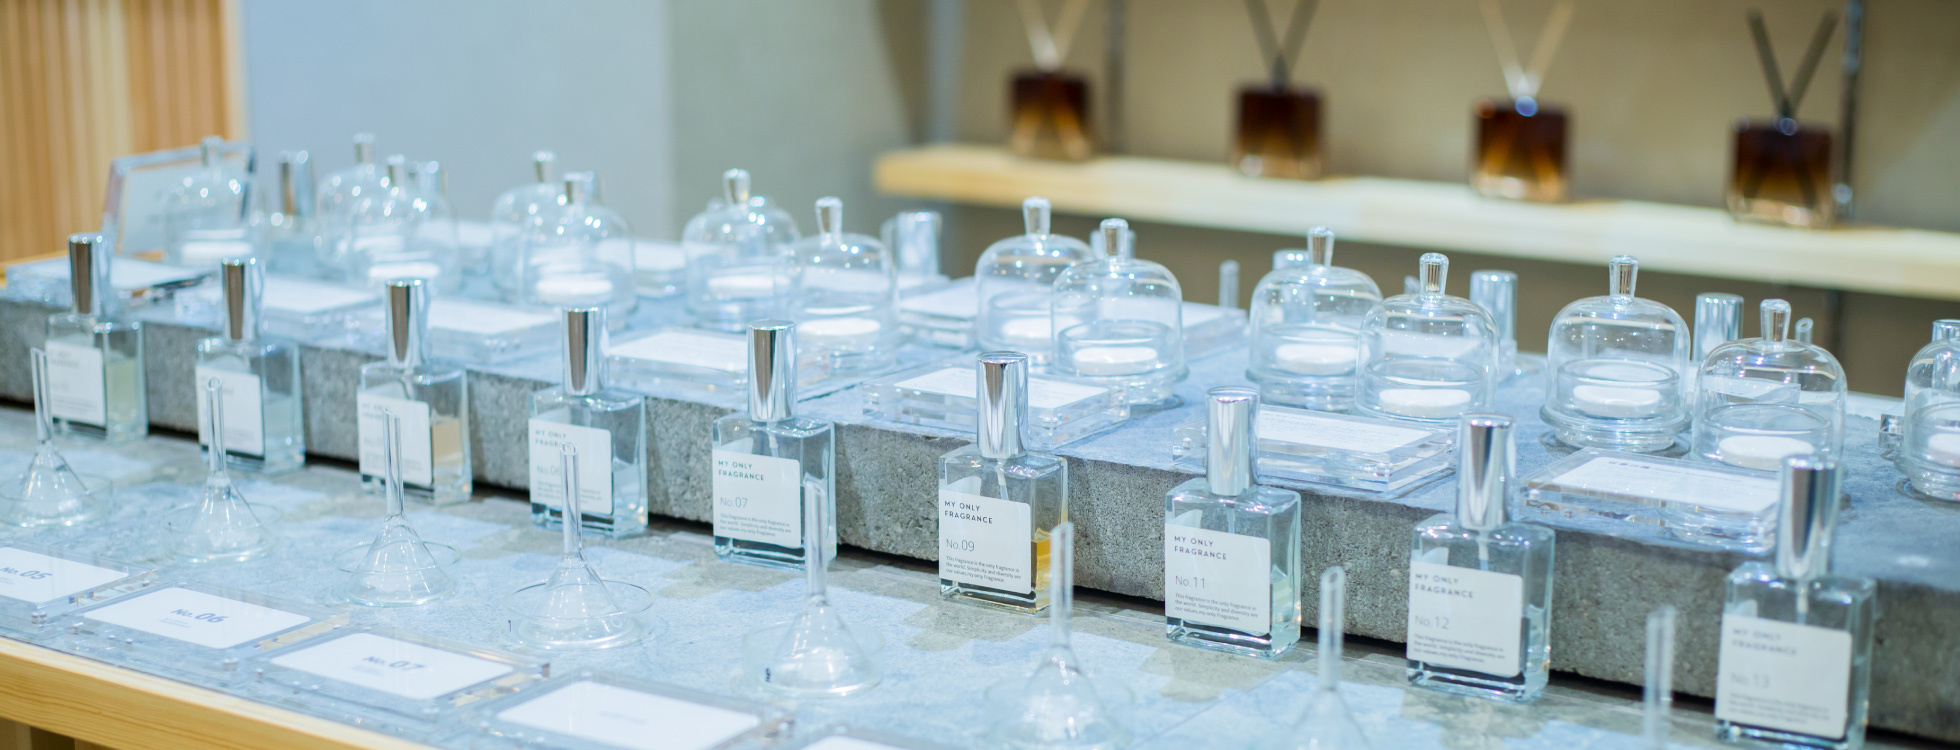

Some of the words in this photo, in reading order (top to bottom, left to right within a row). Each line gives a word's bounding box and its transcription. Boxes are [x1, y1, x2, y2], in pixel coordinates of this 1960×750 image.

[718, 470, 764, 481] FRAGRANCE
[720, 496, 748, 508] No.07
[960, 503, 980, 512] ONLY
[945, 510, 993, 524] FRAGRANCE
[946, 539, 974, 552] No.09
[1190, 538, 1213, 547] ONLY
[1174, 546, 1227, 560] FRAGRANCE
[955, 557, 974, 565] fragrance
[996, 564, 1015, 572] fragrance
[967, 566, 987, 574] Simplicity
[1175, 575, 1205, 588] No.11
[1433, 575, 1458, 584] ONLY
[1415, 583, 1473, 599] FRAGRANCE
[1185, 595, 1206, 603] fragrance
[1230, 602, 1251, 610] fragrance
[1198, 603, 1220, 612] Simplicity
[1230, 609, 1250, 617] diversity
[1415, 615, 1450, 630] No.12
